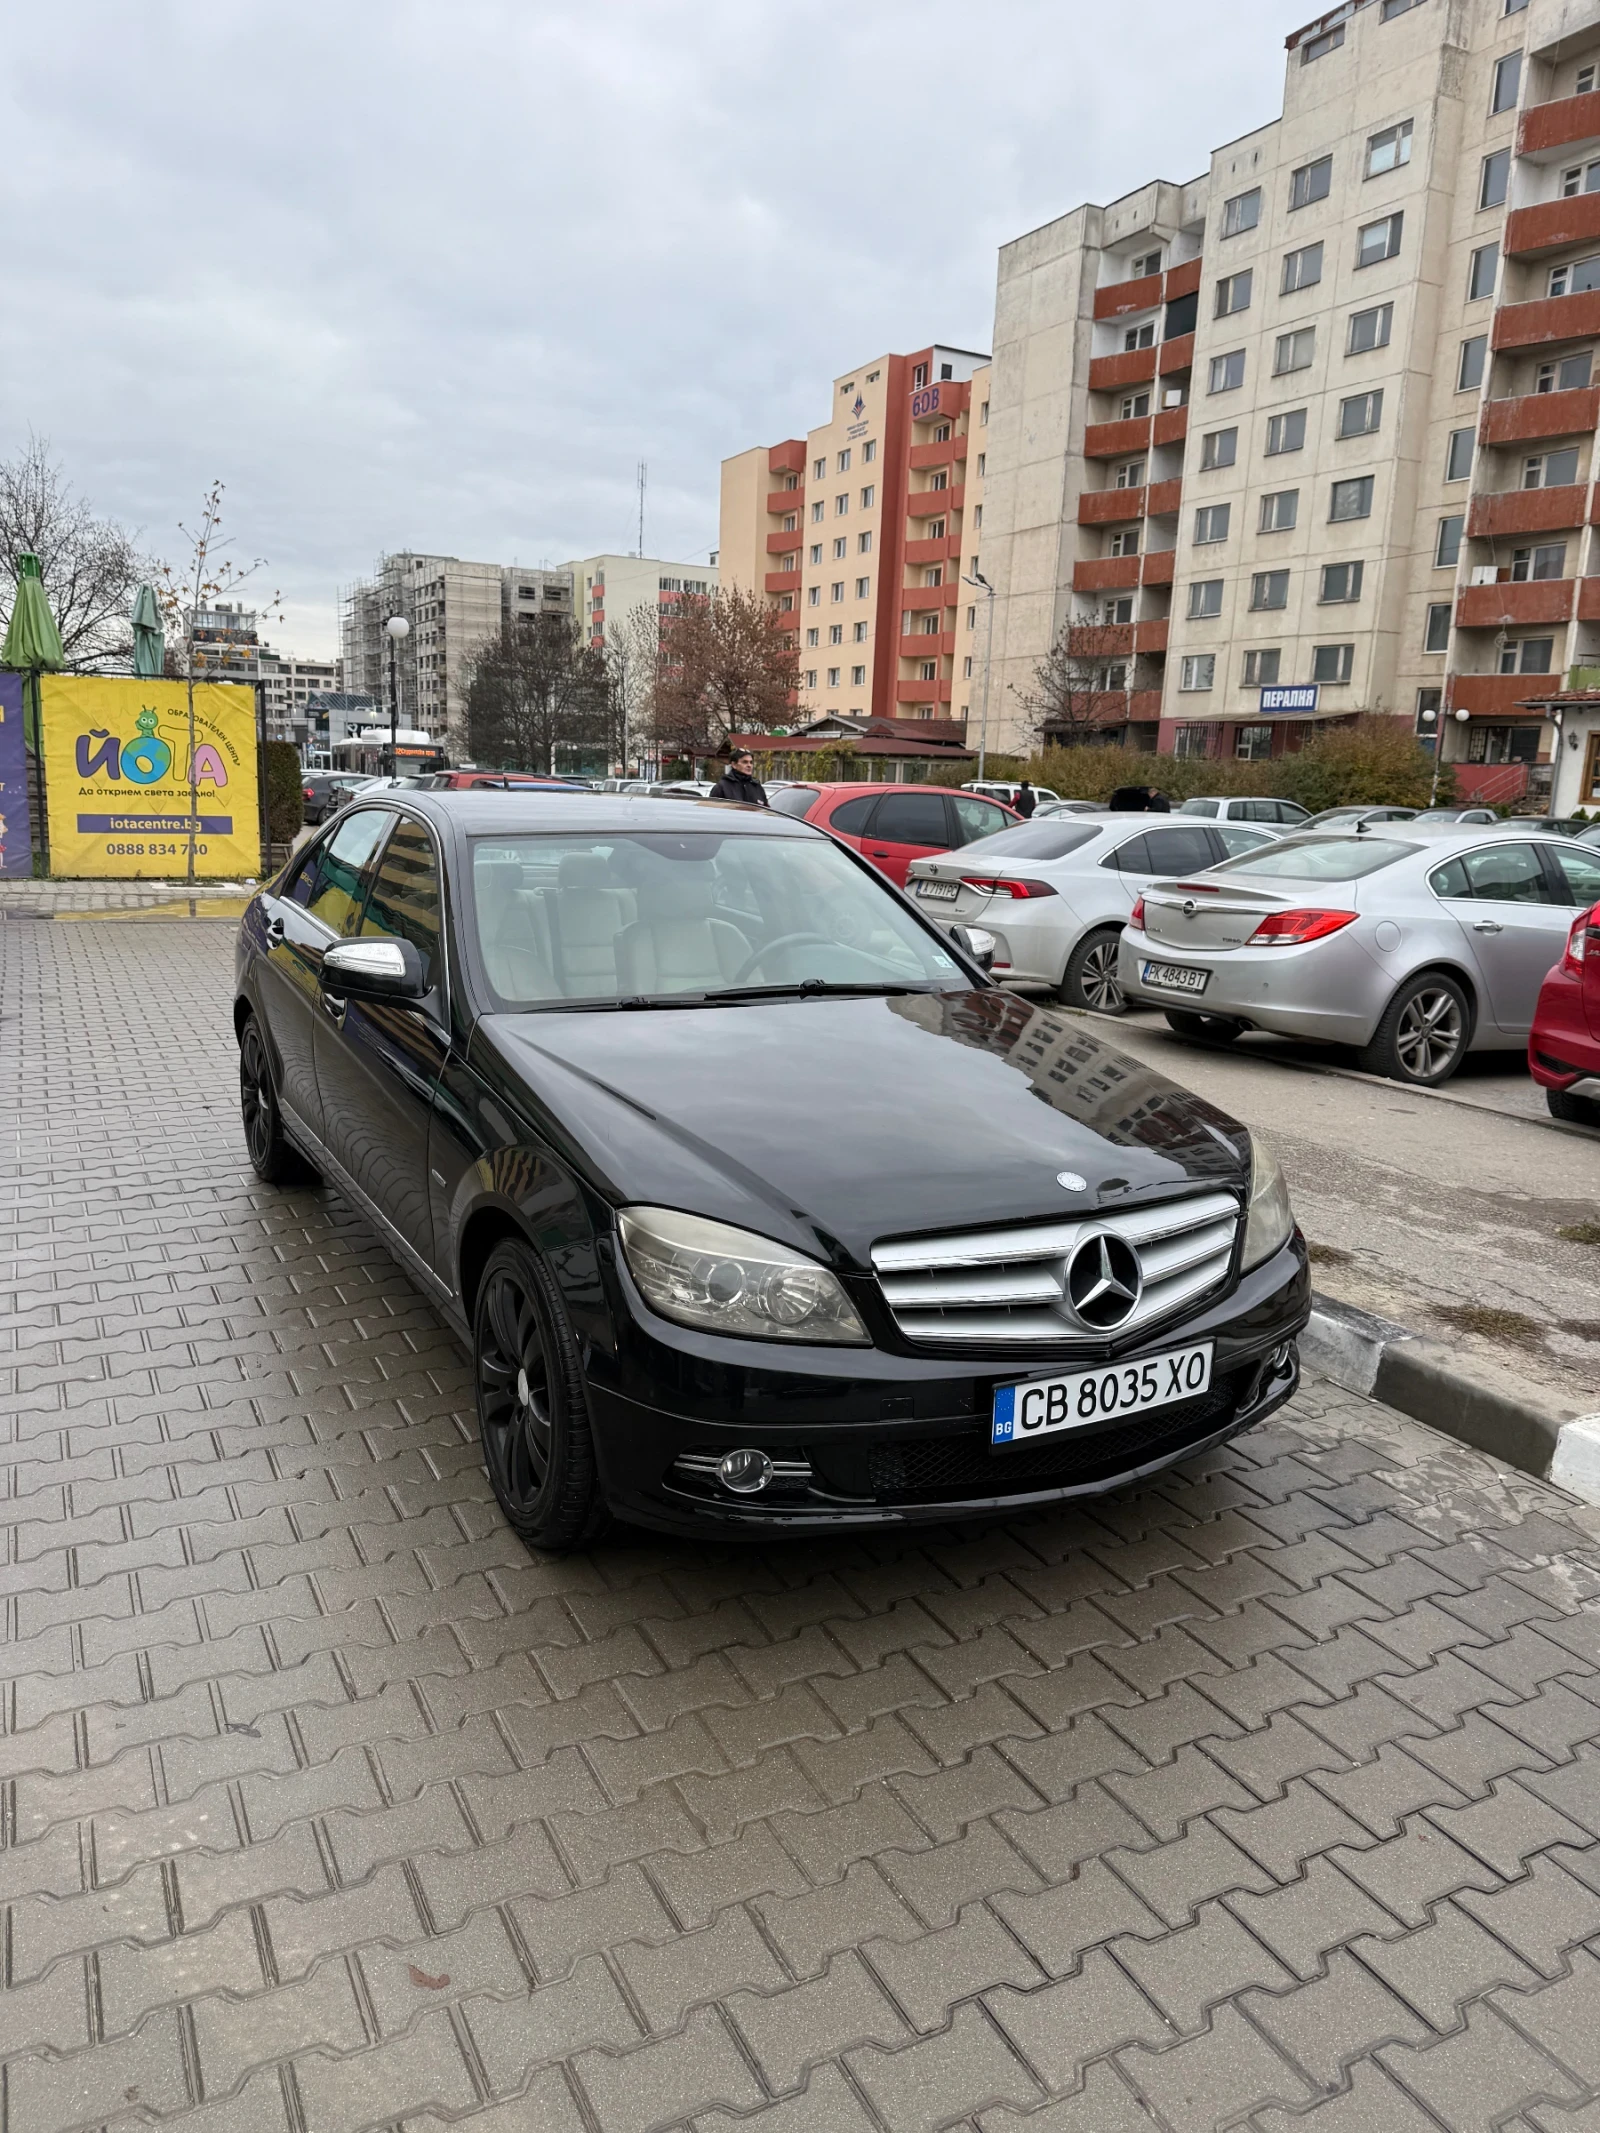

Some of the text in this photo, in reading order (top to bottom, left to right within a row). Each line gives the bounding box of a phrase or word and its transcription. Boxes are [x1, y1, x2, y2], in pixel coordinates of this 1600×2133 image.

[1262, 689, 1315, 708] ПЕРАЛНЯ
[167, 708, 228, 742] ОБРАОВАТЕЛЕН
[76, 724, 228, 788] ЙОТА
[78, 787, 94, 796] Да
[96, 788, 142, 797] открием
[144, 789, 174, 797] света
[110, 817, 202, 832] iotacentre.bg
[106, 843, 145, 855] 0888
[148, 843, 177, 855] 834
[922, 881, 928, 893] A
[1148, 965, 1163, 981] PK
[1162, 967, 1188, 984] 4843
[1188, 972, 1205, 987] BT
[1021, 1351, 1205, 1430] CB 8035 XO
[995, 1421, 1012, 1437] BG
